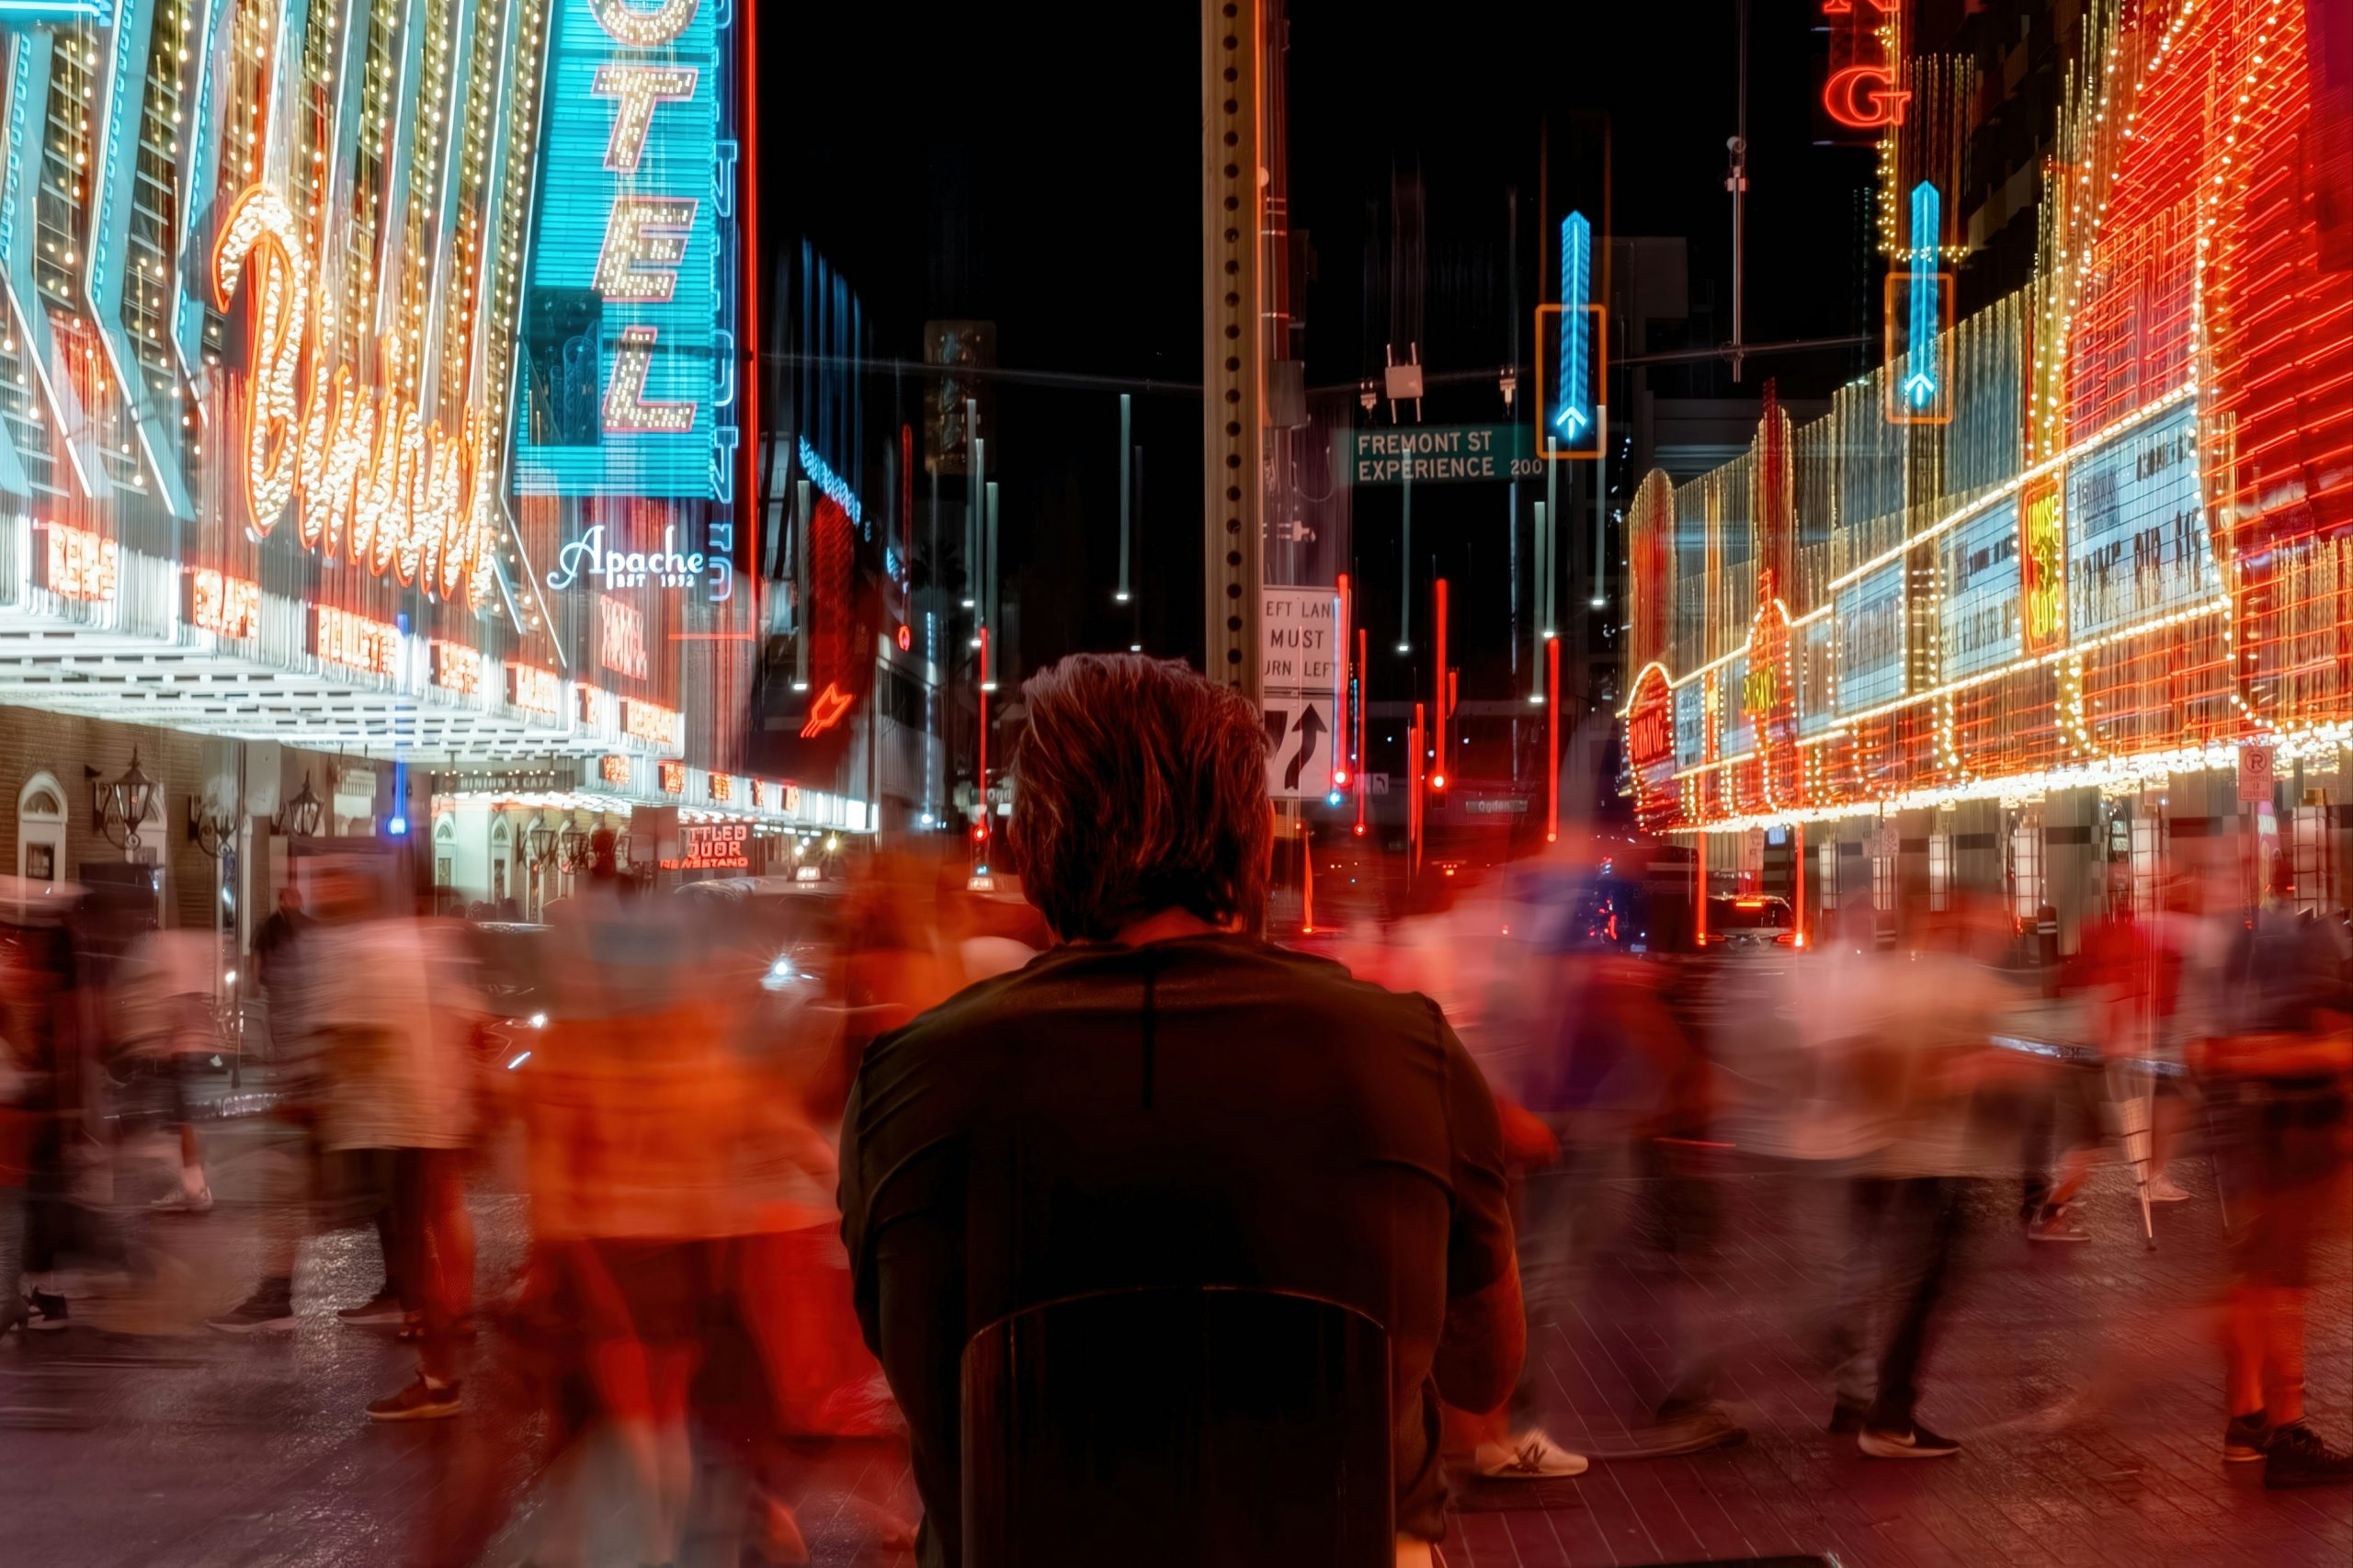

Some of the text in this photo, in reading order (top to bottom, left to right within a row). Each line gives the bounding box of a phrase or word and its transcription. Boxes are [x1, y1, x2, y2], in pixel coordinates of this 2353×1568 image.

[1358, 431, 1493, 456] FREMONT ST
[1358, 457, 1543, 481] EXPERIENCE 200
[546, 525, 704, 590] Apache
[1266, 600, 1336, 619] EFT LAN
[1270, 629, 1324, 649] MUST
